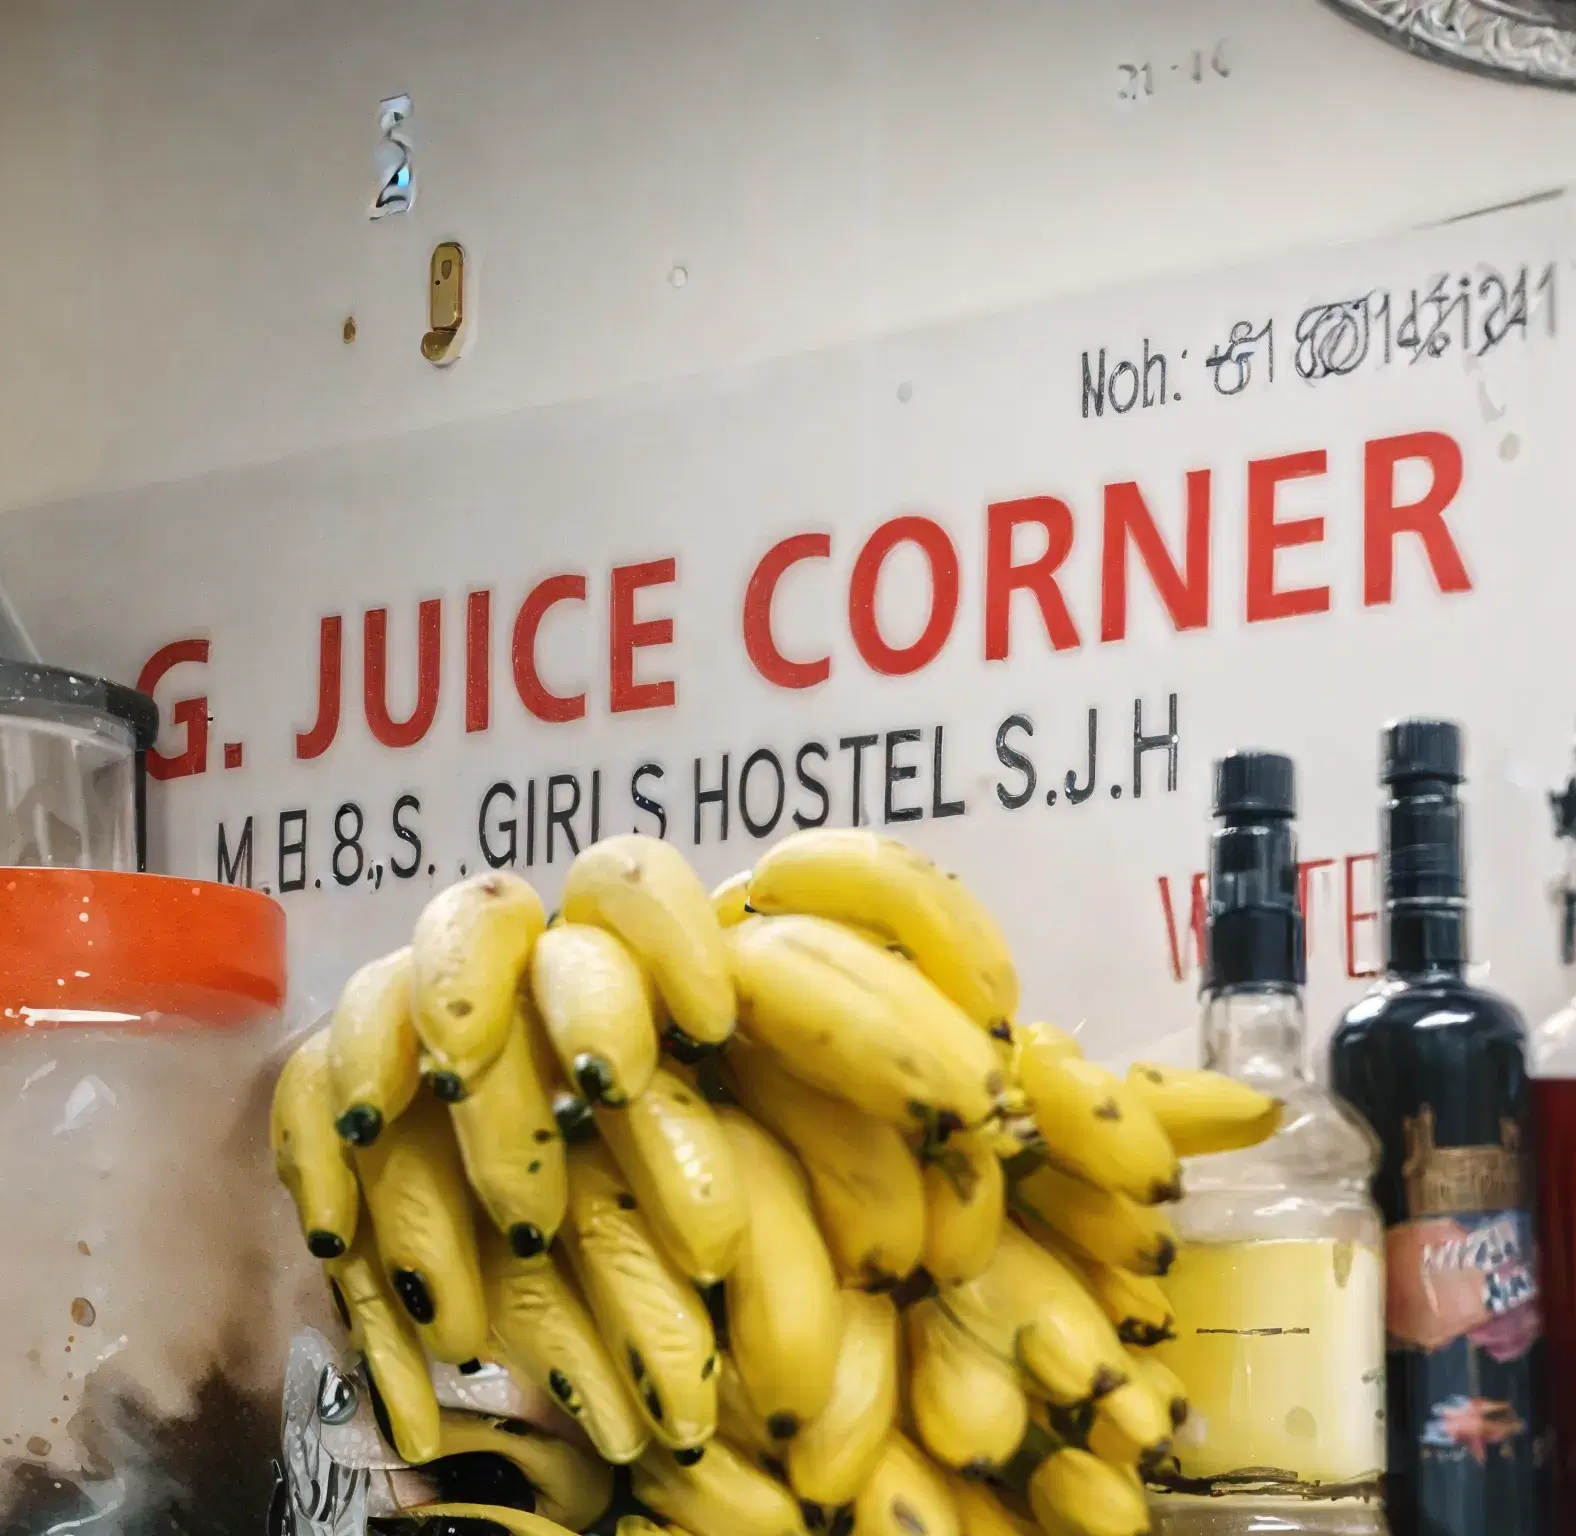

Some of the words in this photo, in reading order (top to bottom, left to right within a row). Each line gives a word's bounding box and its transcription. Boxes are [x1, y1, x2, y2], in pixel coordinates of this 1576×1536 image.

[296, 557, 677, 760] JUICE
[744, 430, 1472, 690] CORNER
[694, 725, 966, 845] HOSTEL
[995, 693, 1179, 811] S.J.H
